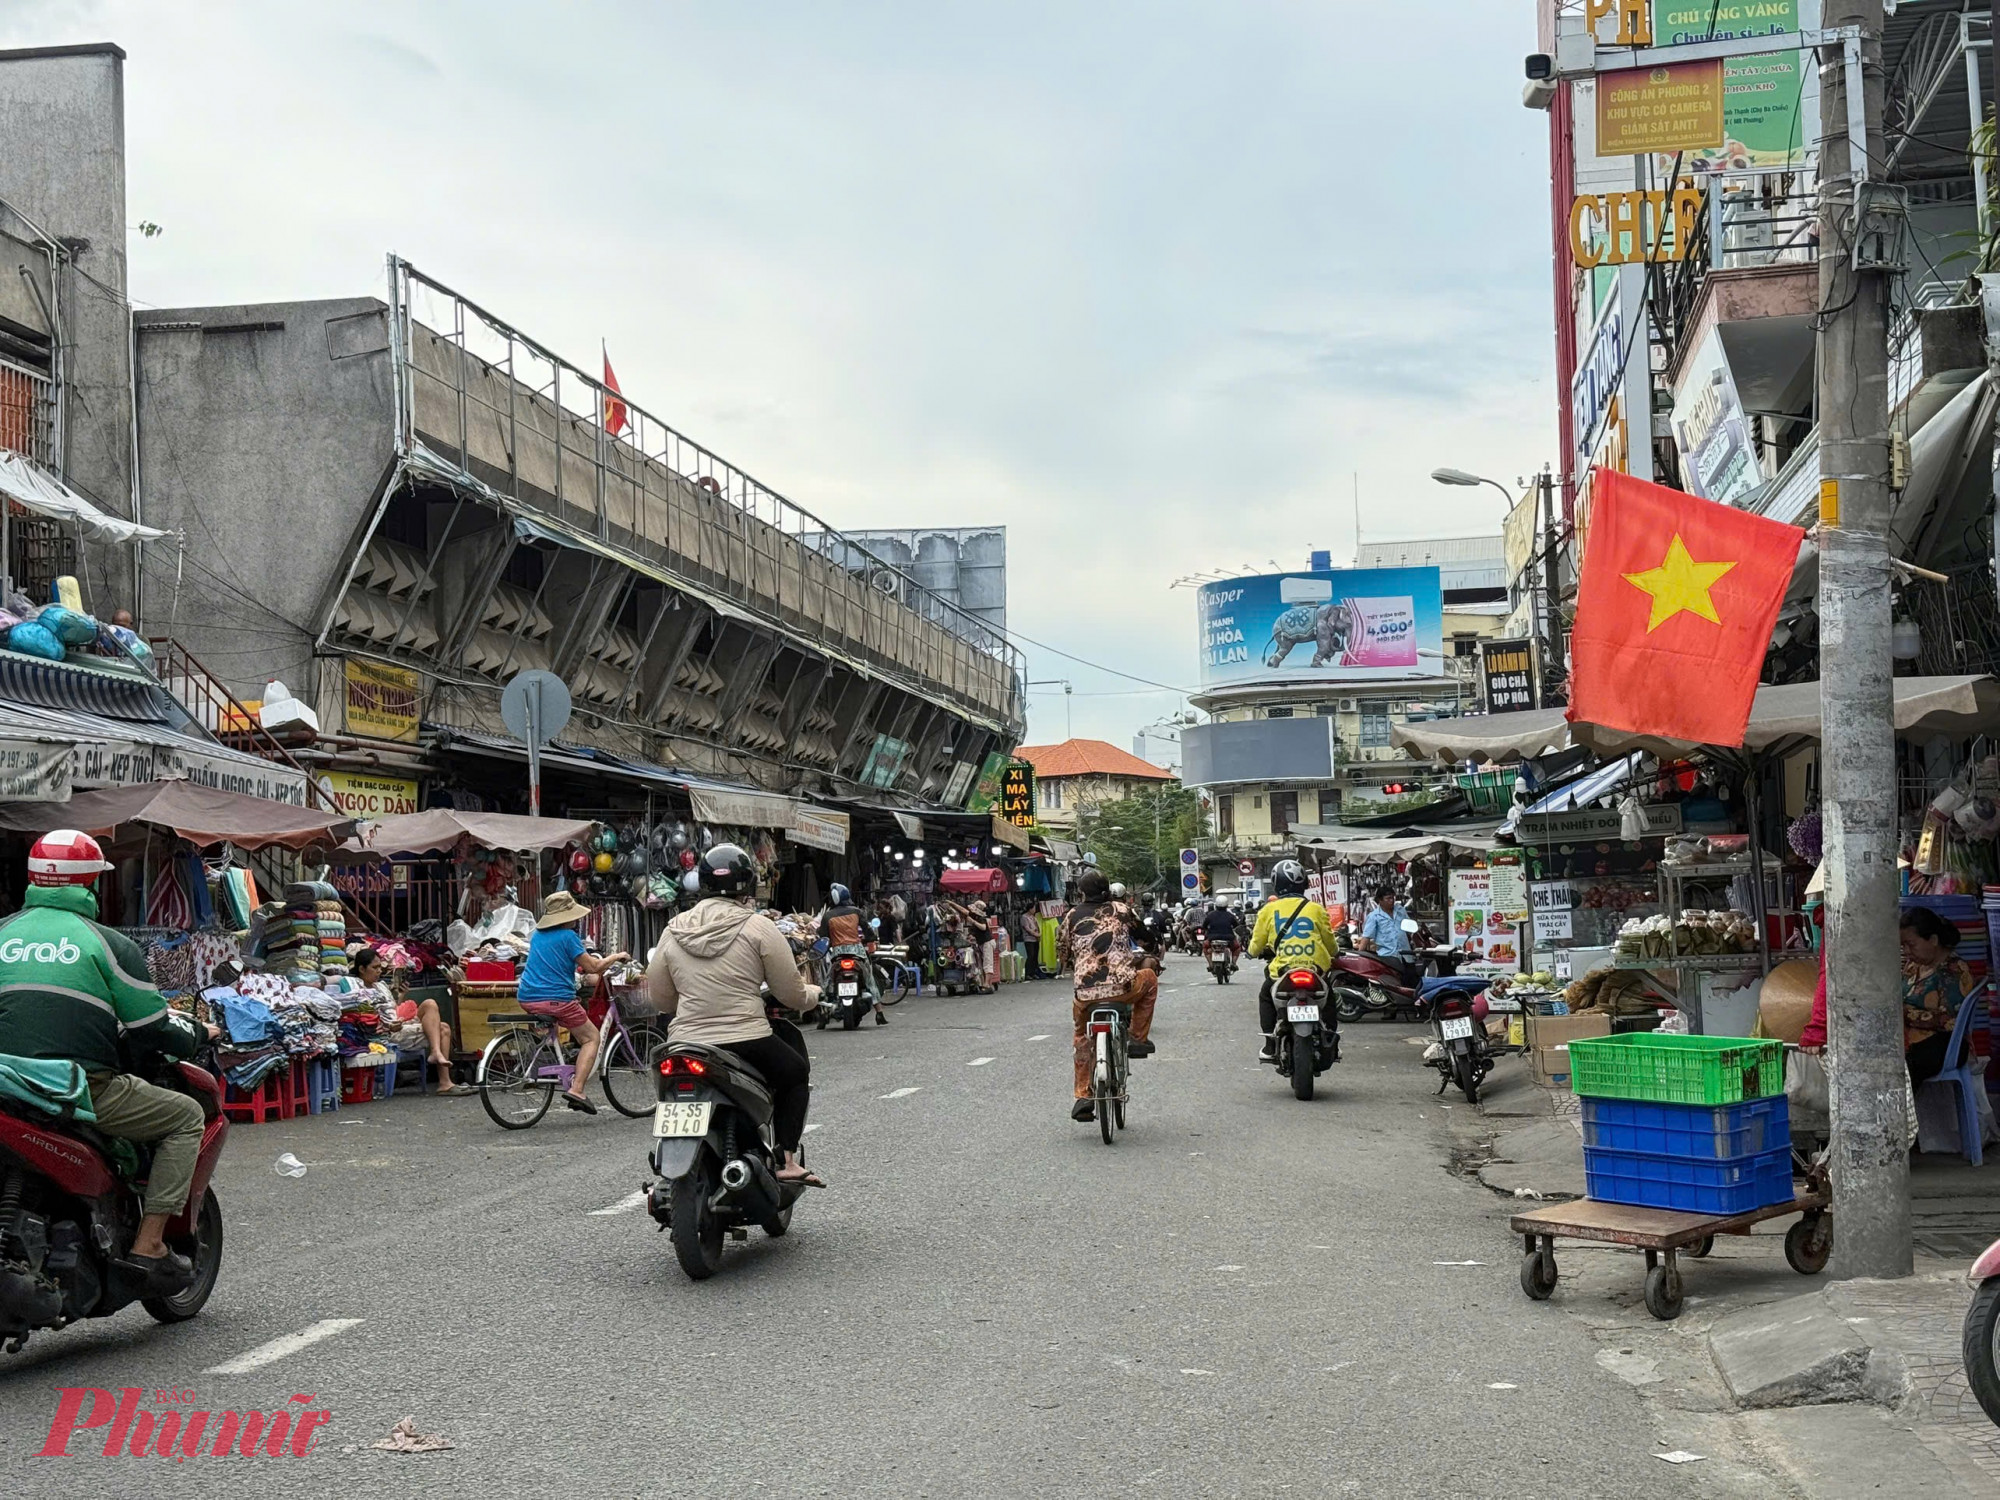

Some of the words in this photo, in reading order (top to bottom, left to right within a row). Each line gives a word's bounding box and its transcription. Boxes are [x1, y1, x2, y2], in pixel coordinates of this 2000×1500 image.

[1744, 2, 1790, 18] VÀNG
[1610, 90, 1638, 103] CÔNG
[1640, 88, 1655, 101] AN
[1658, 85, 1700, 99] PHƯỜNG
[1703, 84, 1709, 95] 2
[1732, 84, 1753, 93] HOA
[1607, 107, 1628, 120] KHU
[1630, 106, 1650, 120] VỰC
[1653, 103, 1667, 116] CÓ
[1670, 101, 1713, 114] CAMERA
[1621, 121, 1648, 135] GIÁM
[1650, 119, 1669, 133] SÁT
[1672, 118, 1699, 131] ANTT
[1204, 588, 1244, 608] Casper
[1216, 627, 1245, 645] HÒA
[1219, 645, 1248, 665] LAN
[1491, 673, 1508, 689] GIÒ
[1492, 692, 1510, 707] TẠP
[1511, 688, 1530, 704] HÓA
[7, 750, 20, 769] 197
[26, 752, 39, 769] 198
[132, 750, 151, 783] TÓC
[1010, 769, 1023, 780] XI
[347, 778, 363, 788] TIỆM
[364, 781, 377, 791] BẠC
[379, 783, 391, 791] CAO
[1006, 784, 1028, 796] MẠ
[383, 794, 416, 814] DÂN
[1004, 796, 1031, 811] LẤY
[1525, 822, 1558, 834] TRẠM
[1561, 819, 1594, 831] NHIỆT
[1324, 874, 1340, 885] VALI
[1533, 886, 1550, 907] CHÈ
[1552, 884, 1570, 906] THÁI
[1274, 910, 1314, 939] be
[1545, 929, 1561, 937] 22K
[0, 936, 80, 964] Grab
[663, 1103, 704, 1118] 54-S5
[661, 1120, 701, 1134] 6140
